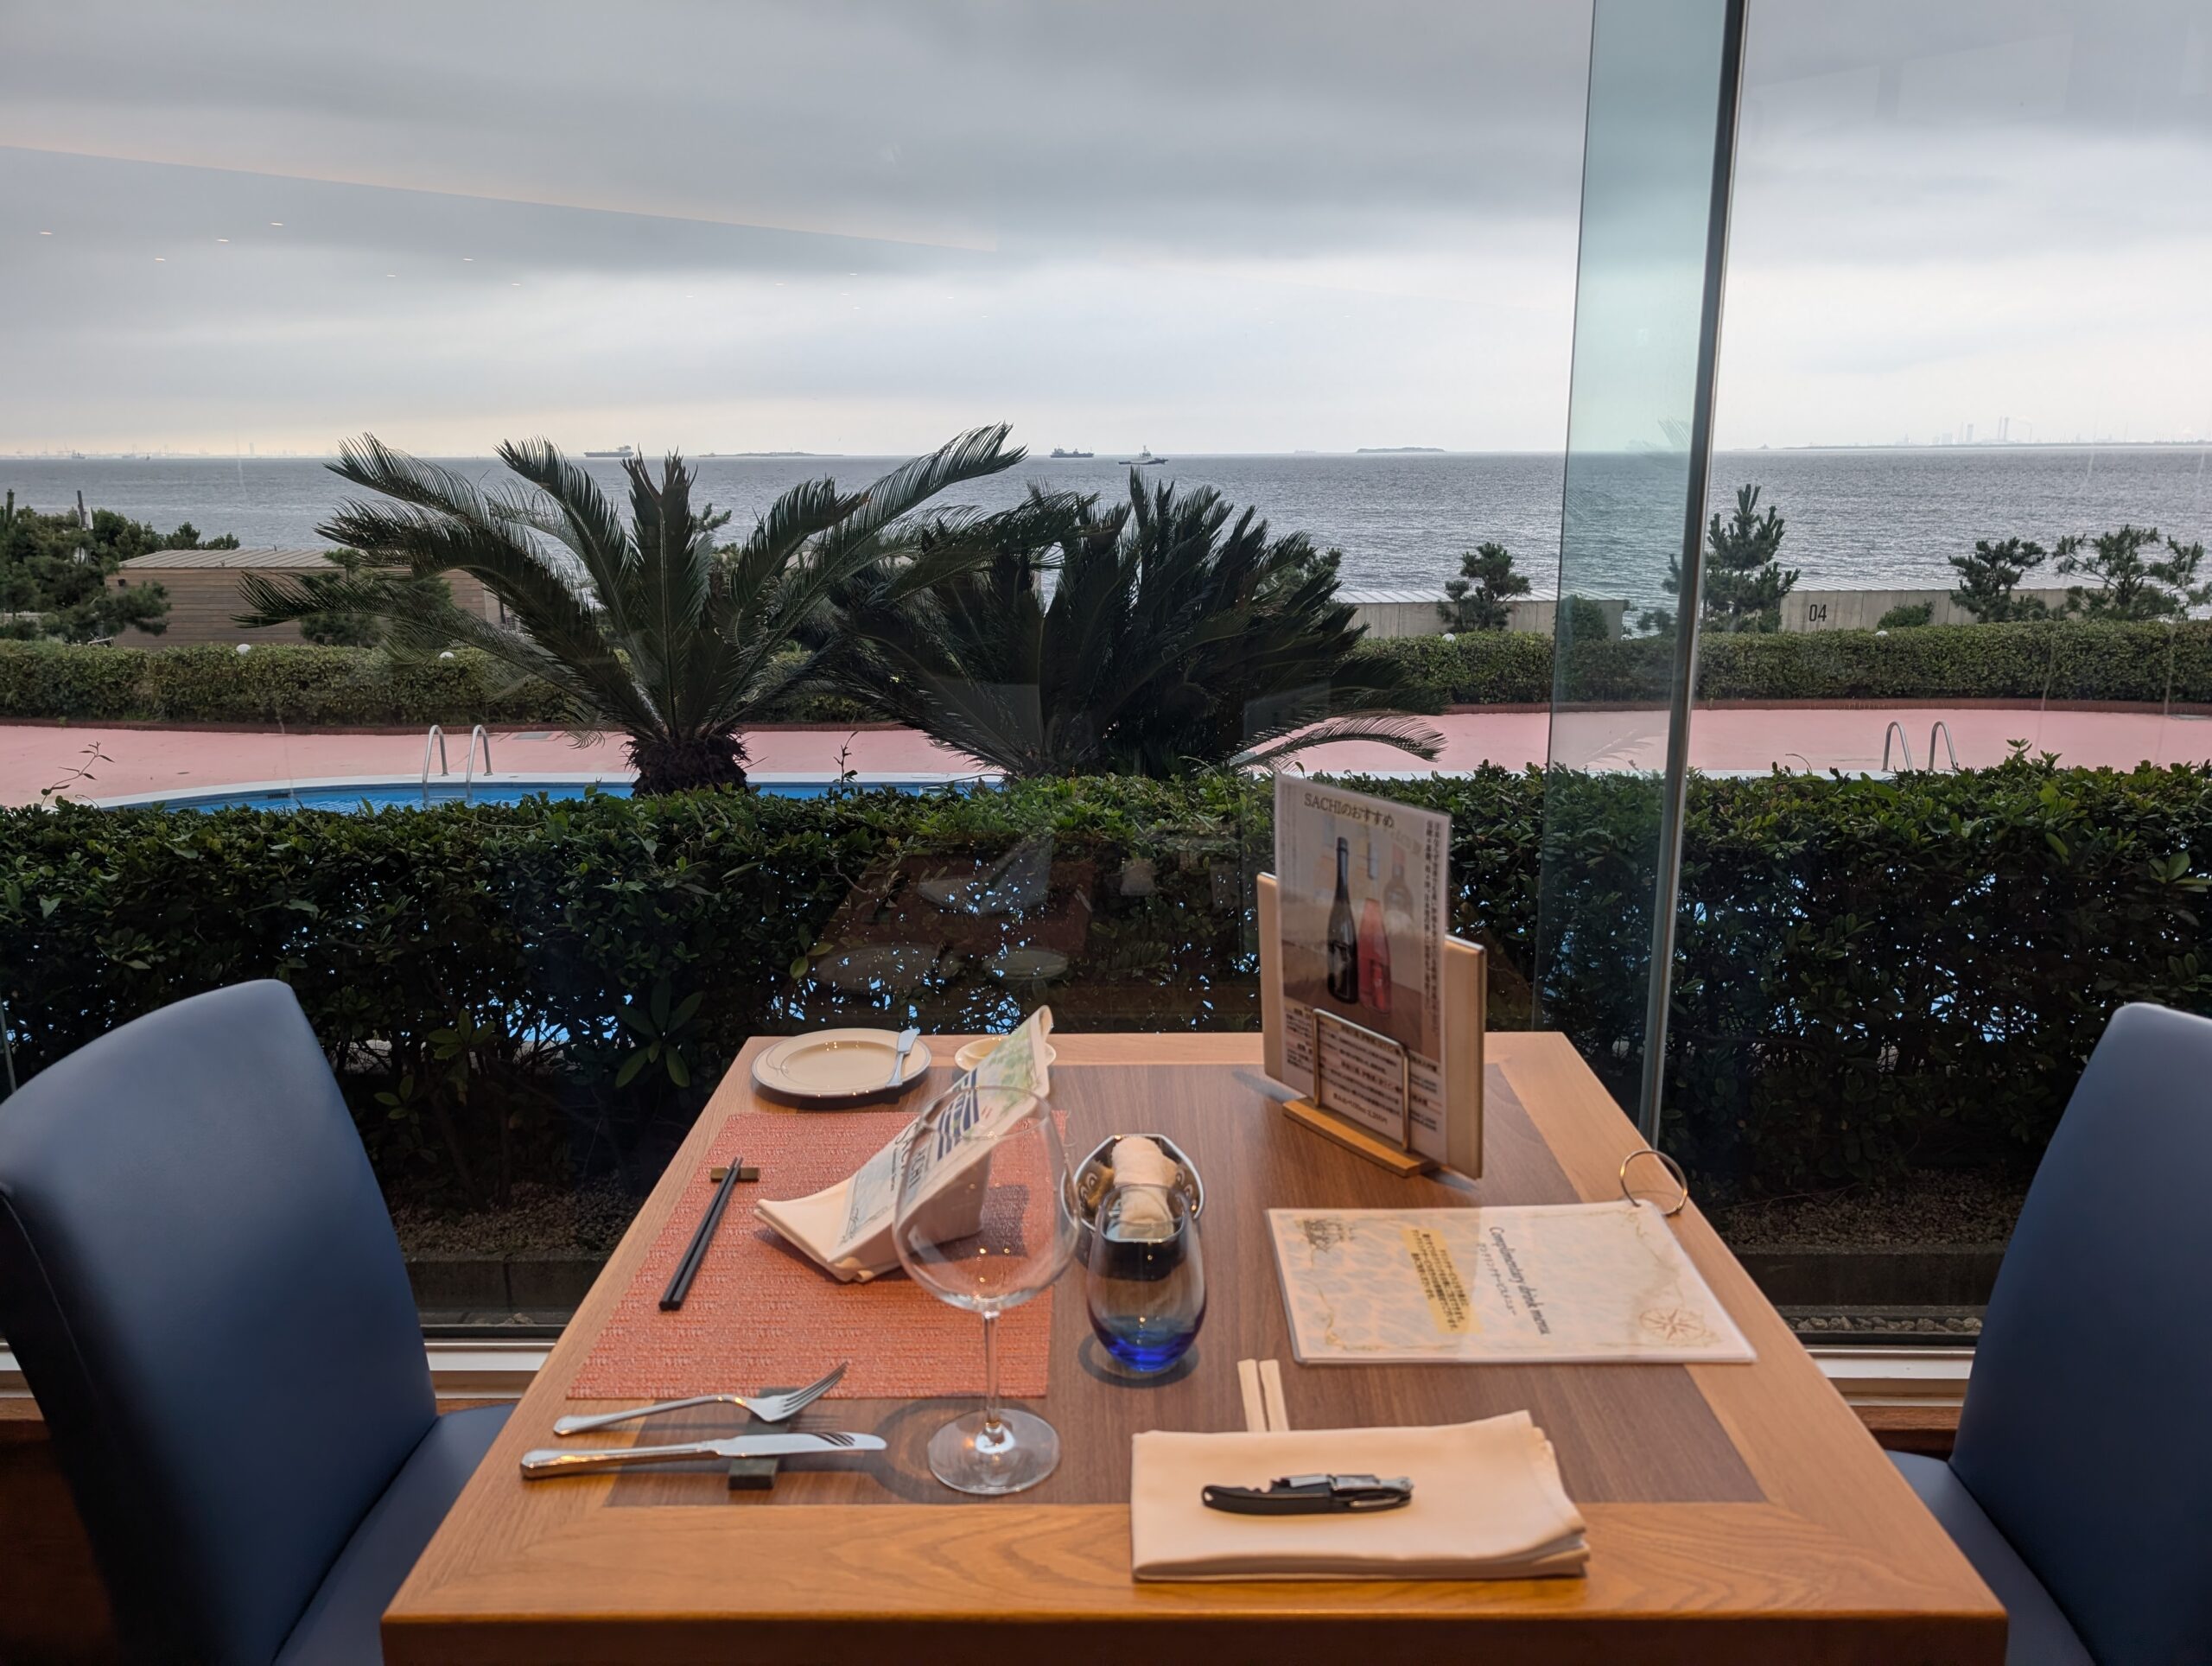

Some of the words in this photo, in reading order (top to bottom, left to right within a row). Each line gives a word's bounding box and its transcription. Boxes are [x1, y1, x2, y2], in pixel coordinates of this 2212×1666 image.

[1808, 604, 1827, 622] 04
[1304, 792, 1395, 829] SACHIのおすすめ
[1489, 1226, 1525, 1284] Complimentary
[1518, 1285, 1544, 1308] drink
[1530, 1310, 1551, 1335] menu
